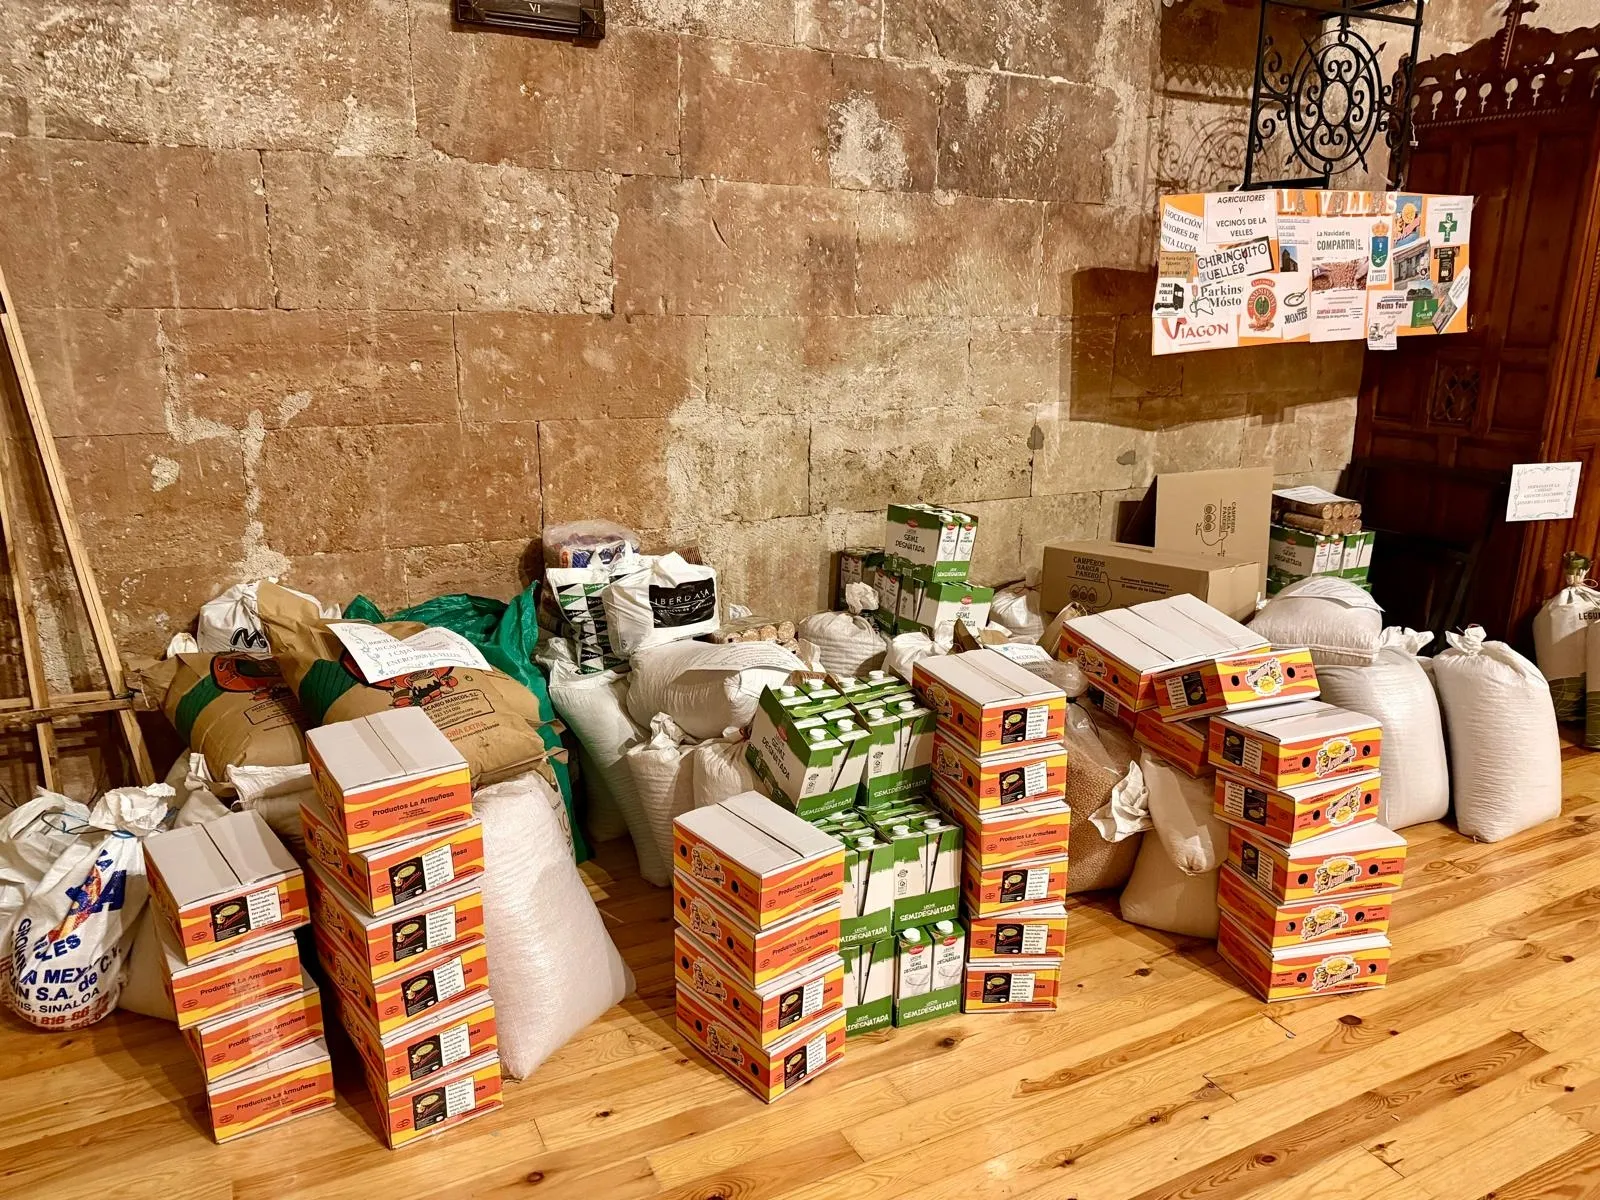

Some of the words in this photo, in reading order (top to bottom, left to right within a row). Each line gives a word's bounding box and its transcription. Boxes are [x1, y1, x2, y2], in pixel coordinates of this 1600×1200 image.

[529, 3, 541, 14] VI
[1217, 194, 1266, 204] AGRICULTORES
[1216, 219, 1246, 227] VECINOS
[1248, 217, 1257, 225] DE
[1189, 232, 1199, 241] DE
[1230, 229, 1253, 237] VELLES
[1316, 239, 1355, 250] COMPARTIR
[1162, 317, 1229, 340] VIAGON
[1073, 556, 1105, 567] CAMPEROS
[423, 702, 445, 712] ACARIO
[372, 803, 408, 817] Productos
[409, 800, 419, 808] La
[420, 790, 455, 806] Armuñesa
[900, 904, 955, 922] SEMIDESNATADA
[839, 926, 888, 943] MIDESNATADA
[36, 987, 73, 1001] S.A.
[78, 972, 98, 992] de
[200, 979, 236, 996] Productos
[39, 987, 100, 1013] SINALOA
[903, 1000, 958, 1019] SEMIDESNATADA
[846, 1014, 889, 1031] IDESNATADA
[228, 1031, 262, 1049] Productos
[236, 1096, 272, 1111] Productos
[283, 1081, 316, 1098] Armuñesa
